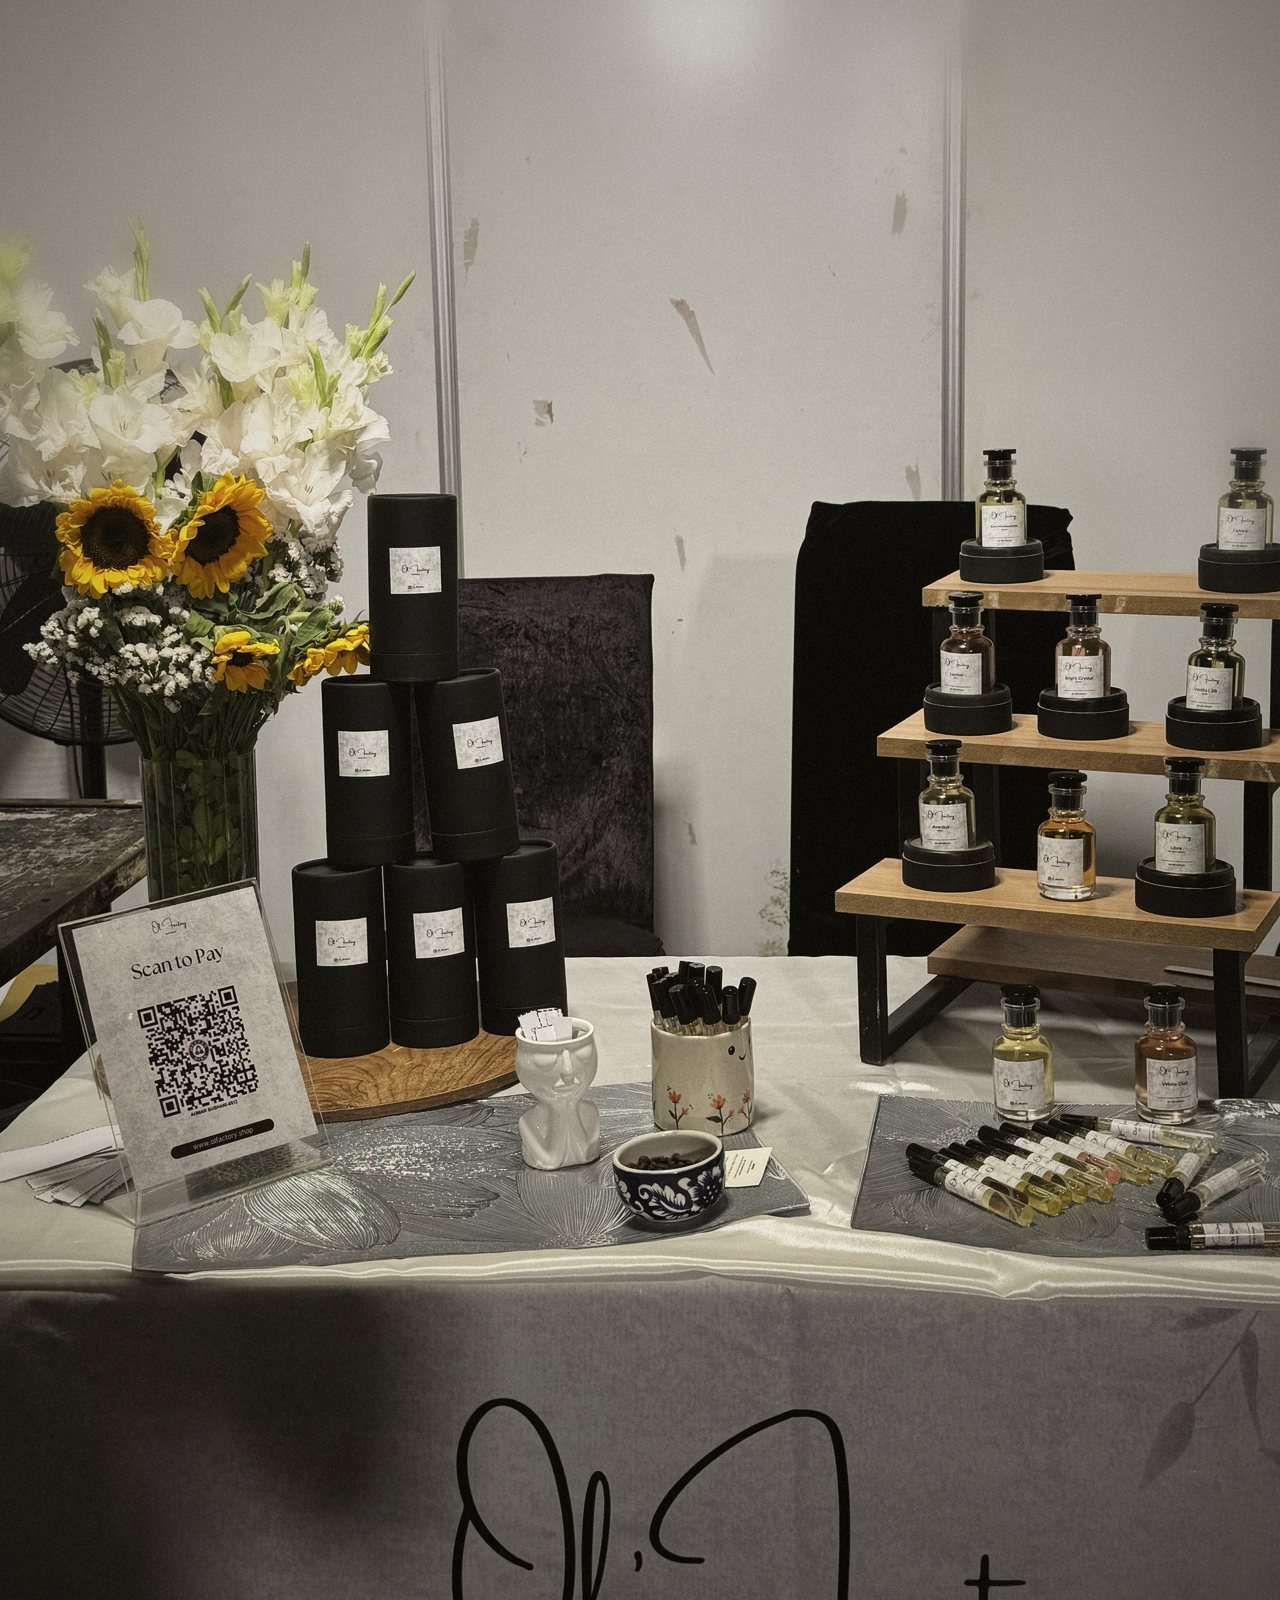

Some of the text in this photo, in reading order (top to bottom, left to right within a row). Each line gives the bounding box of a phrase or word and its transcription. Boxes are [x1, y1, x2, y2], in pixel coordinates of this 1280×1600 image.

[131, 946, 224, 980] Scan to Pay
[192, 1127, 254, 1151] www.olfactory.shop
